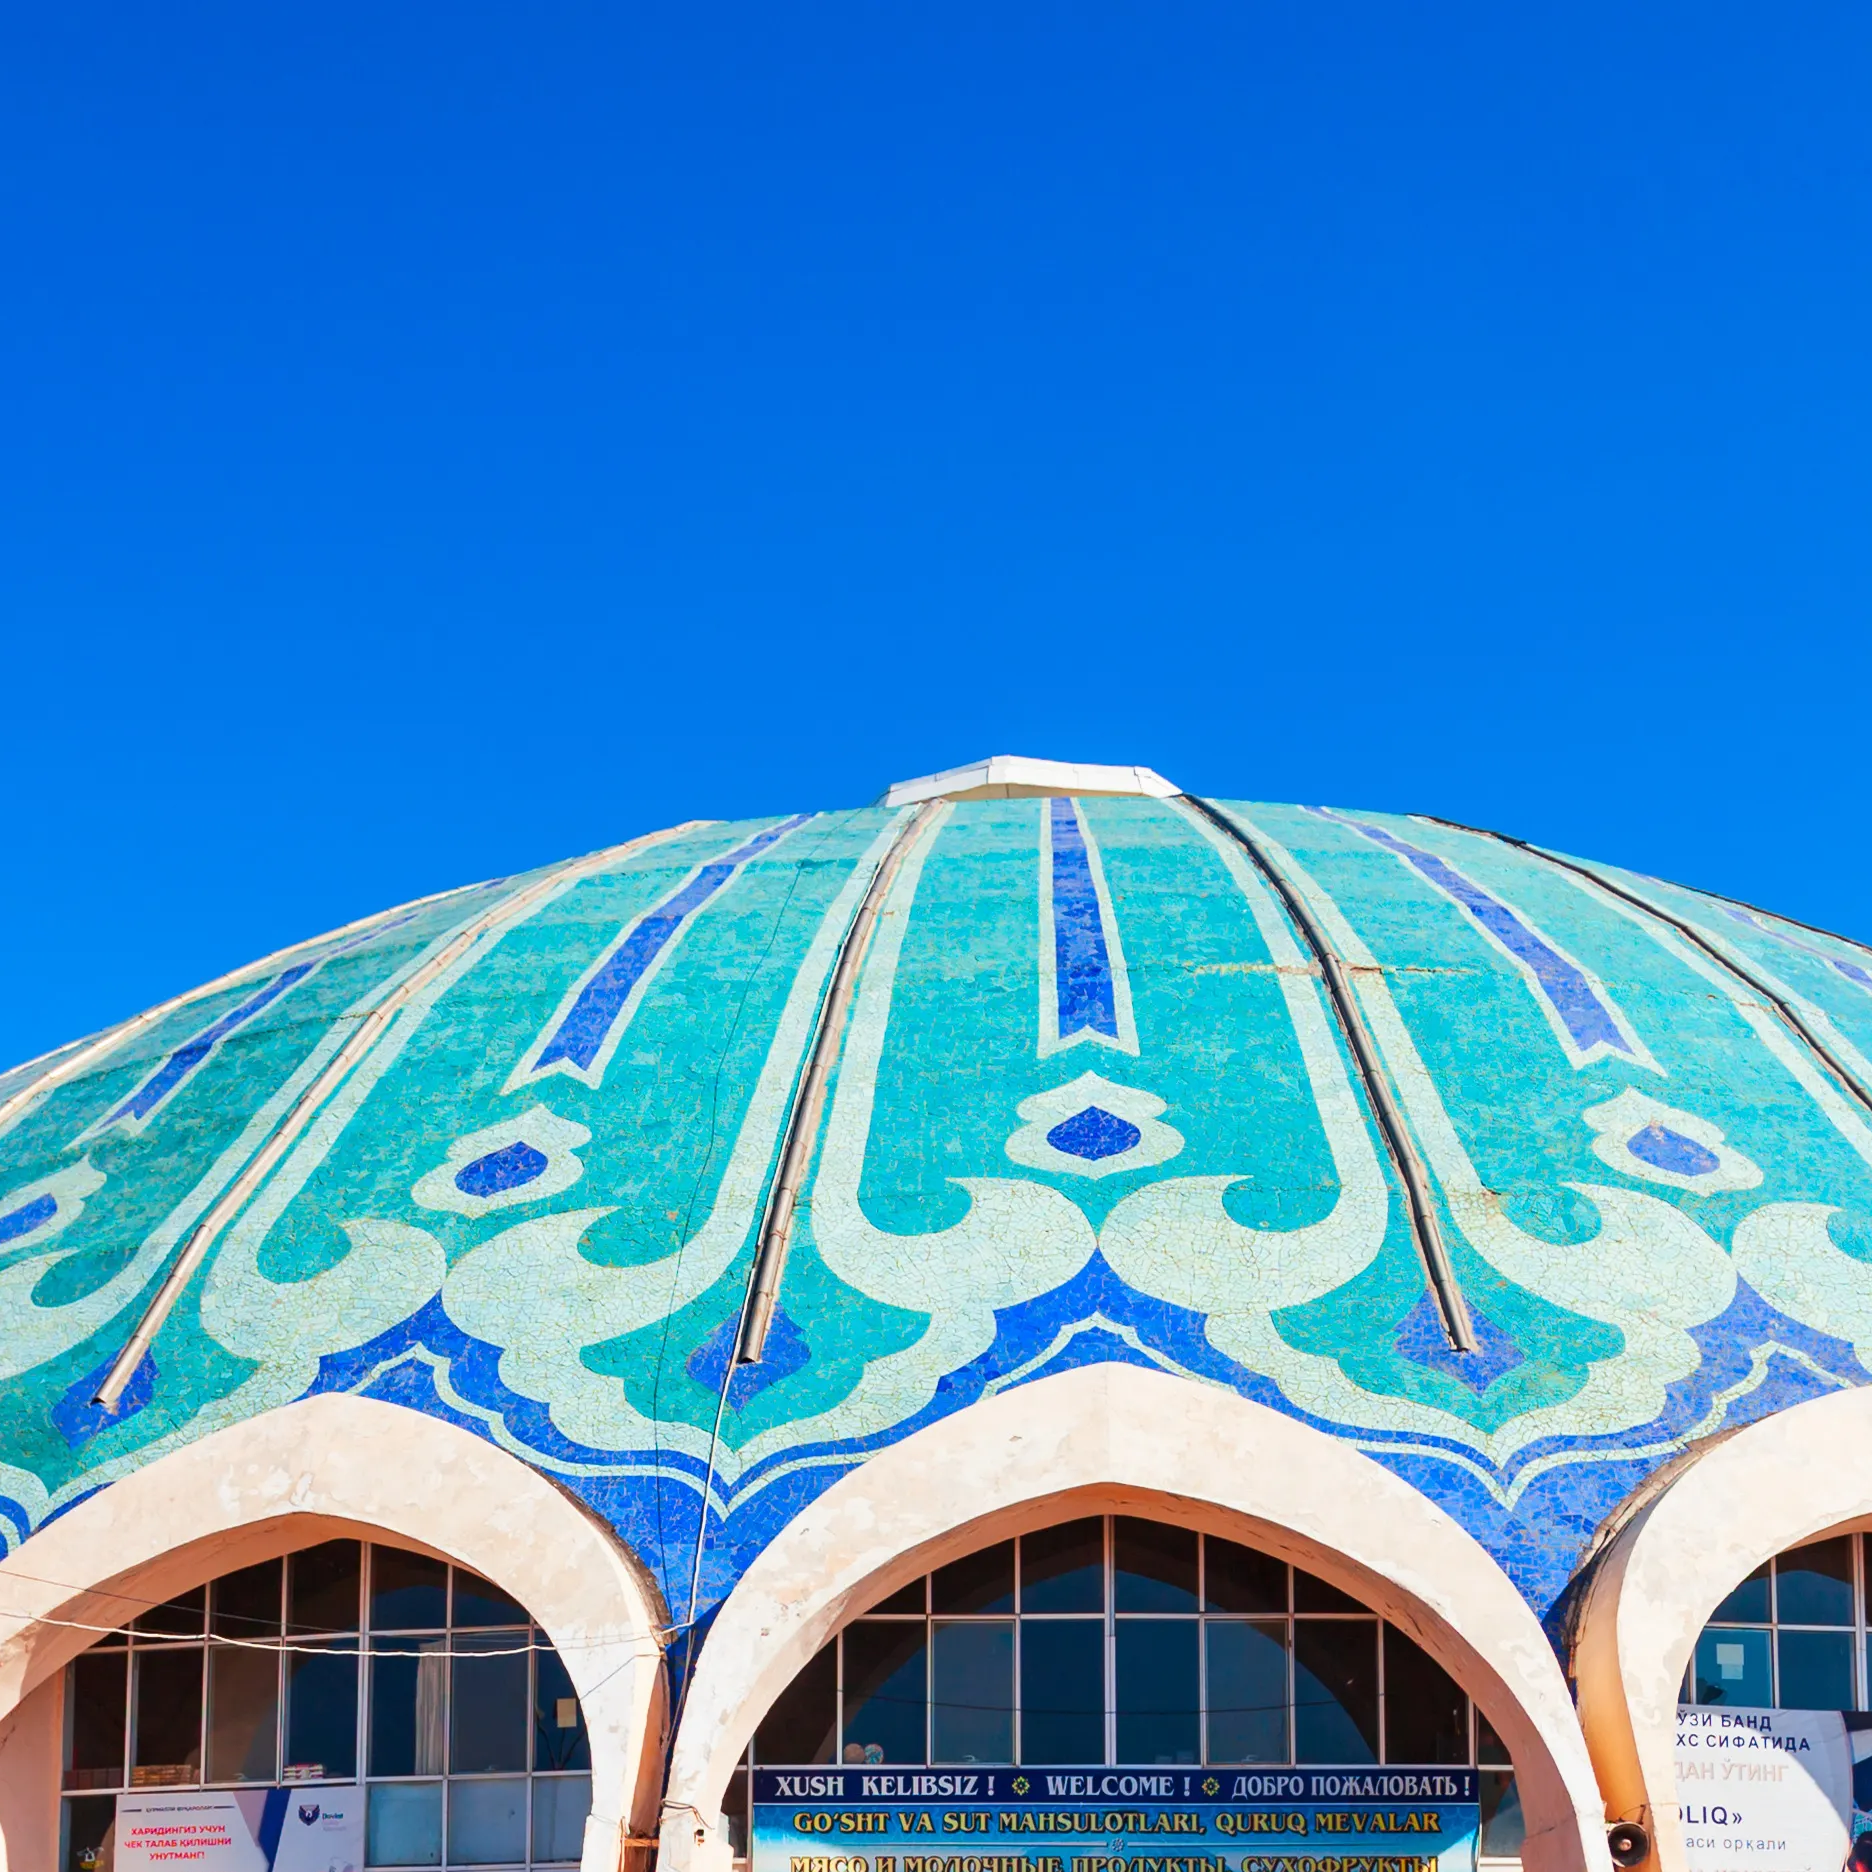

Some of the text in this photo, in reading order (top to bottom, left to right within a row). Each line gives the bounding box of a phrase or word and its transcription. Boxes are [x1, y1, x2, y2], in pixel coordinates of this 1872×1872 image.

[1721, 1714, 1772, 1731] БАНД
[1706, 1734, 1811, 1752] СИФАТИДА
[1721, 1758, 1789, 1782] ЎТИНГ
[775, 1776, 844, 1797] XUSH
[1231, 1776, 1304, 1799] ДОБРО
[131, 1825, 226, 1836] ХАРИДИНГИЗ УЧУН
[897, 1812, 934, 1833] VA
[943, 1812, 991, 1833] SUT
[999, 1812, 1207, 1835] MAHSULOTLARI,
[1215, 1812, 1308, 1836] QURUQ
[1314, 1812, 1441, 1833] MEVALAR
[124, 1838, 232, 1849] ЧЕК ТАЛАБ ҚИЛИШНИ
[1723, 1838, 1786, 1852] орқали
[149, 1851, 205, 1861] УНУТМАНГ!
